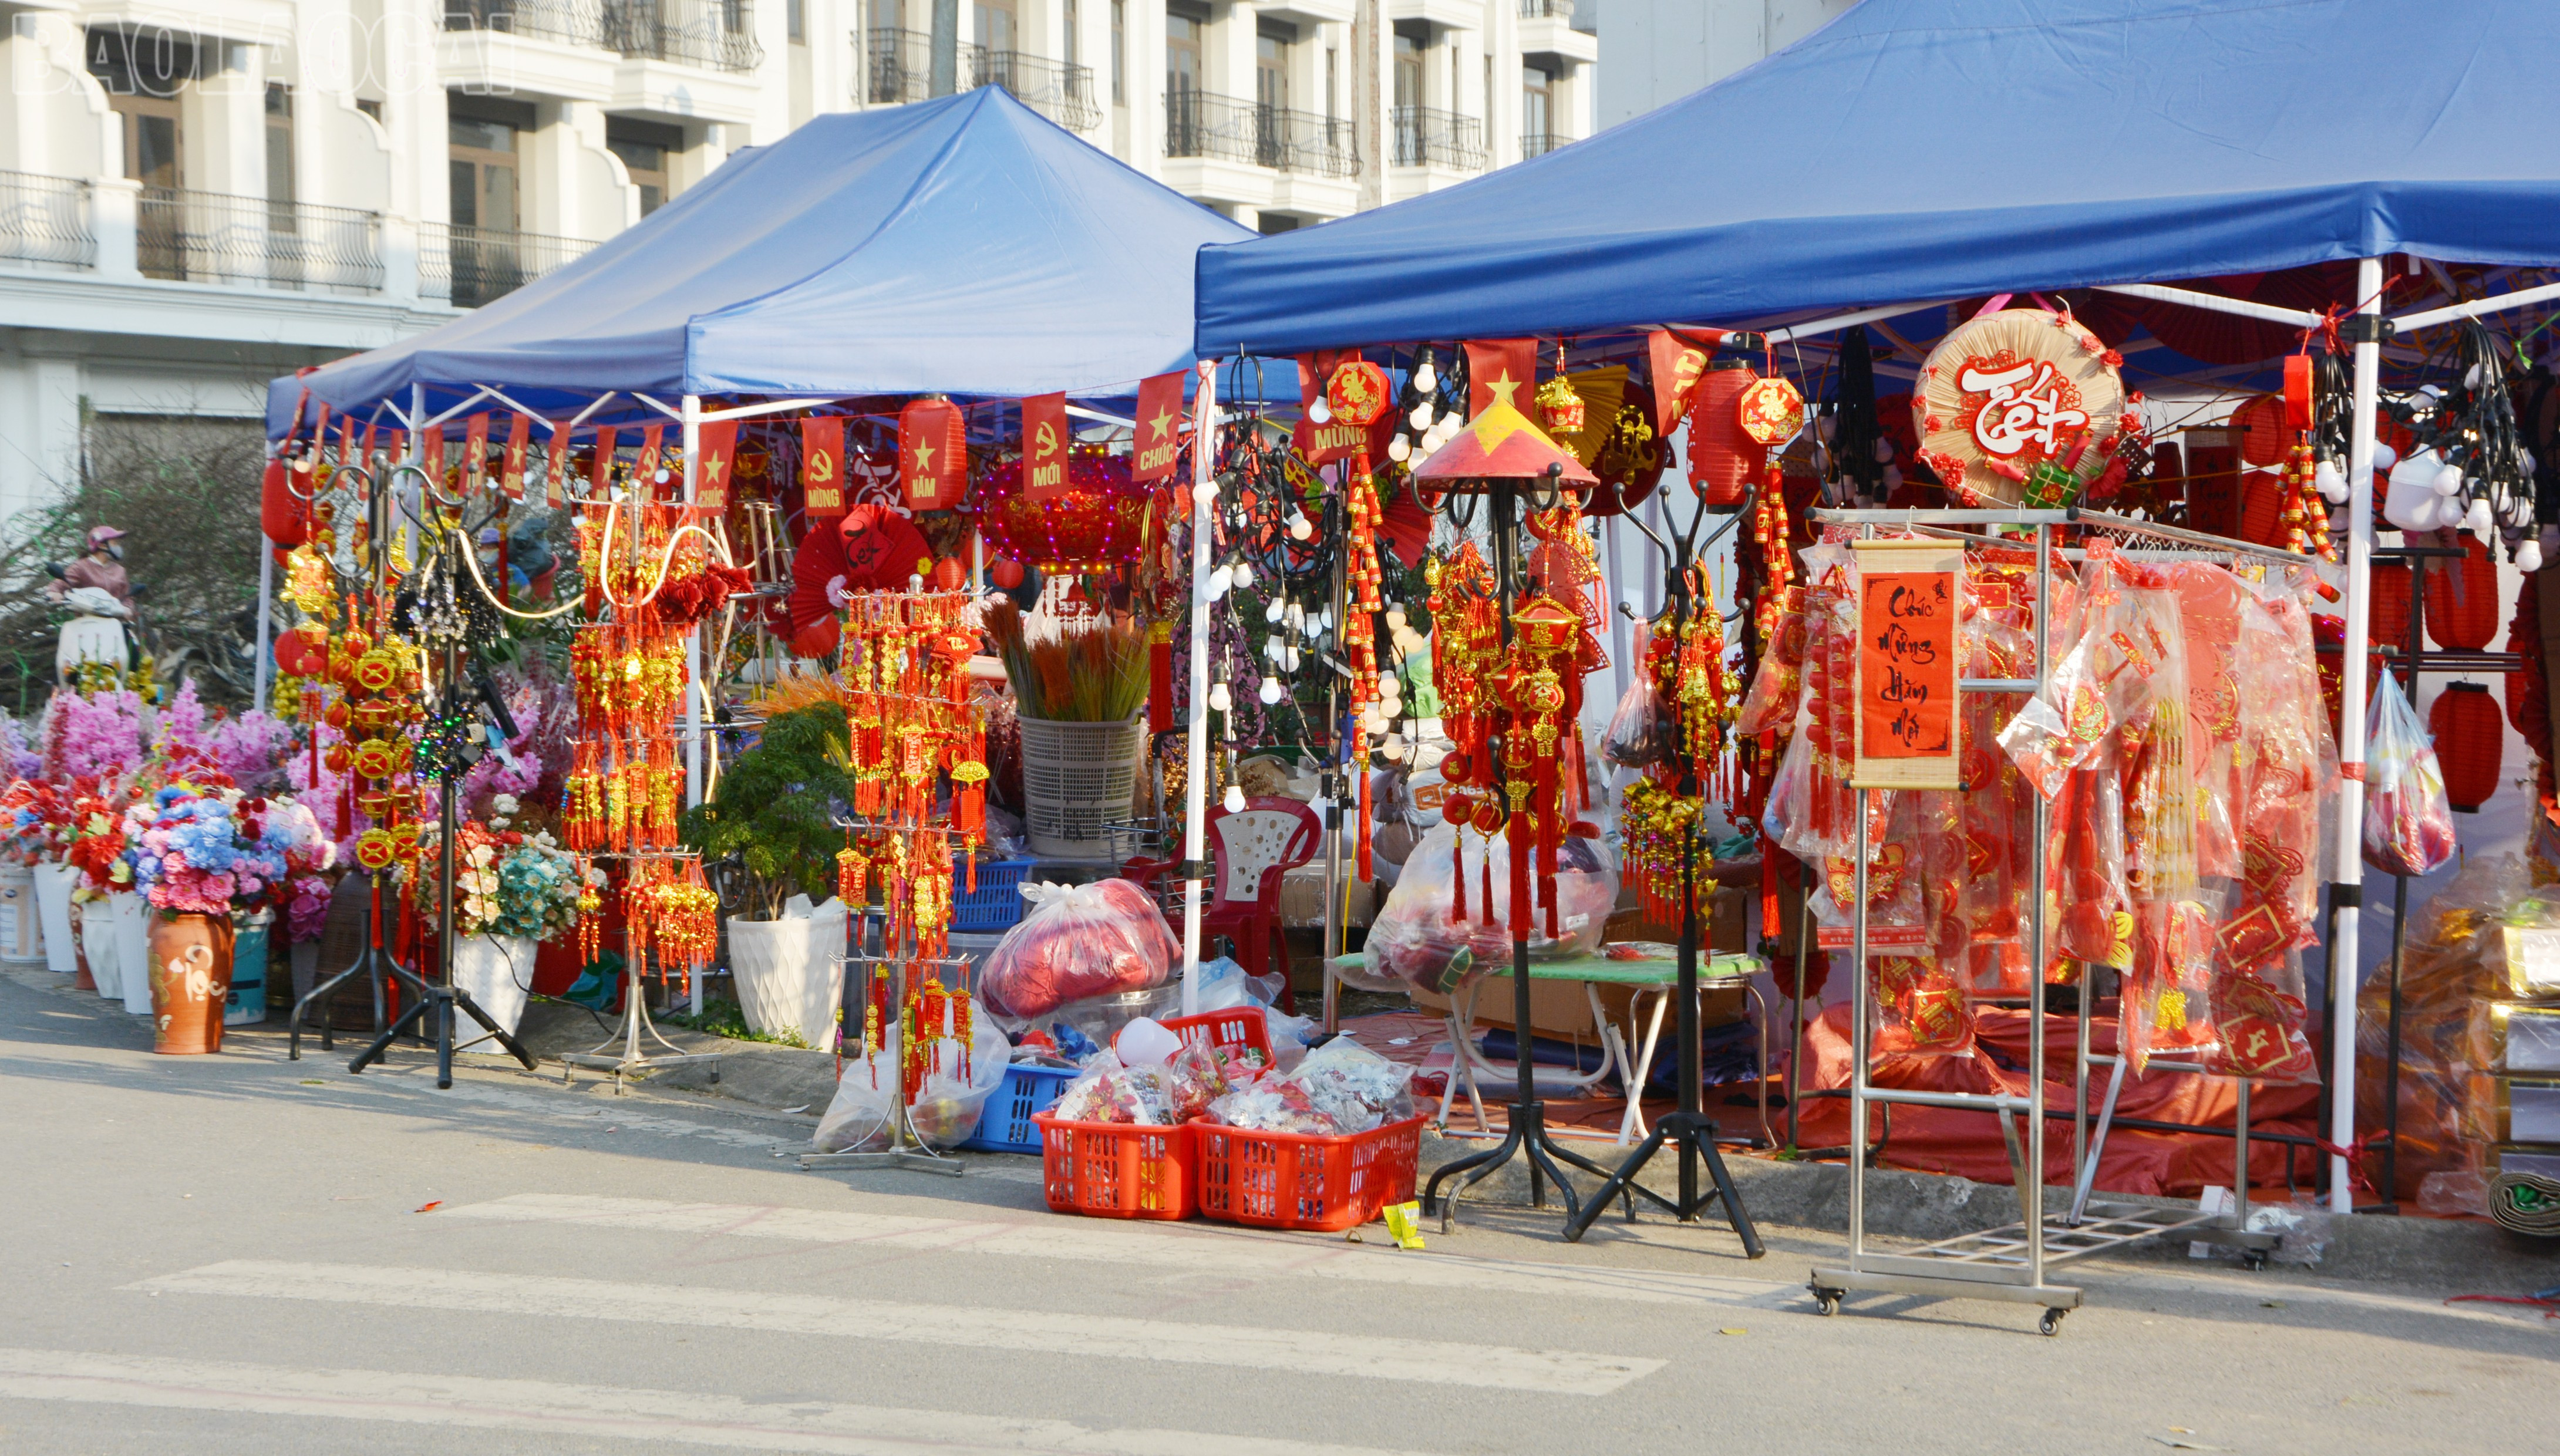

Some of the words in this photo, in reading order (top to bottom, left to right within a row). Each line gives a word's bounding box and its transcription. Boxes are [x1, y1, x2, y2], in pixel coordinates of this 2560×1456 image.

[1962, 362, 2086, 454] Tết
[1140, 442, 1173, 470] CHÚC
[912, 474, 935, 498] NĂM
[1033, 463, 1060, 487] MỚI
[698, 486, 725, 508] CHÚC
[808, 486, 840, 508] MỪNG
[1888, 586, 1934, 618] Chúc
[1877, 622, 1936, 665] Mừng
[1889, 707, 1919, 748] Mới
